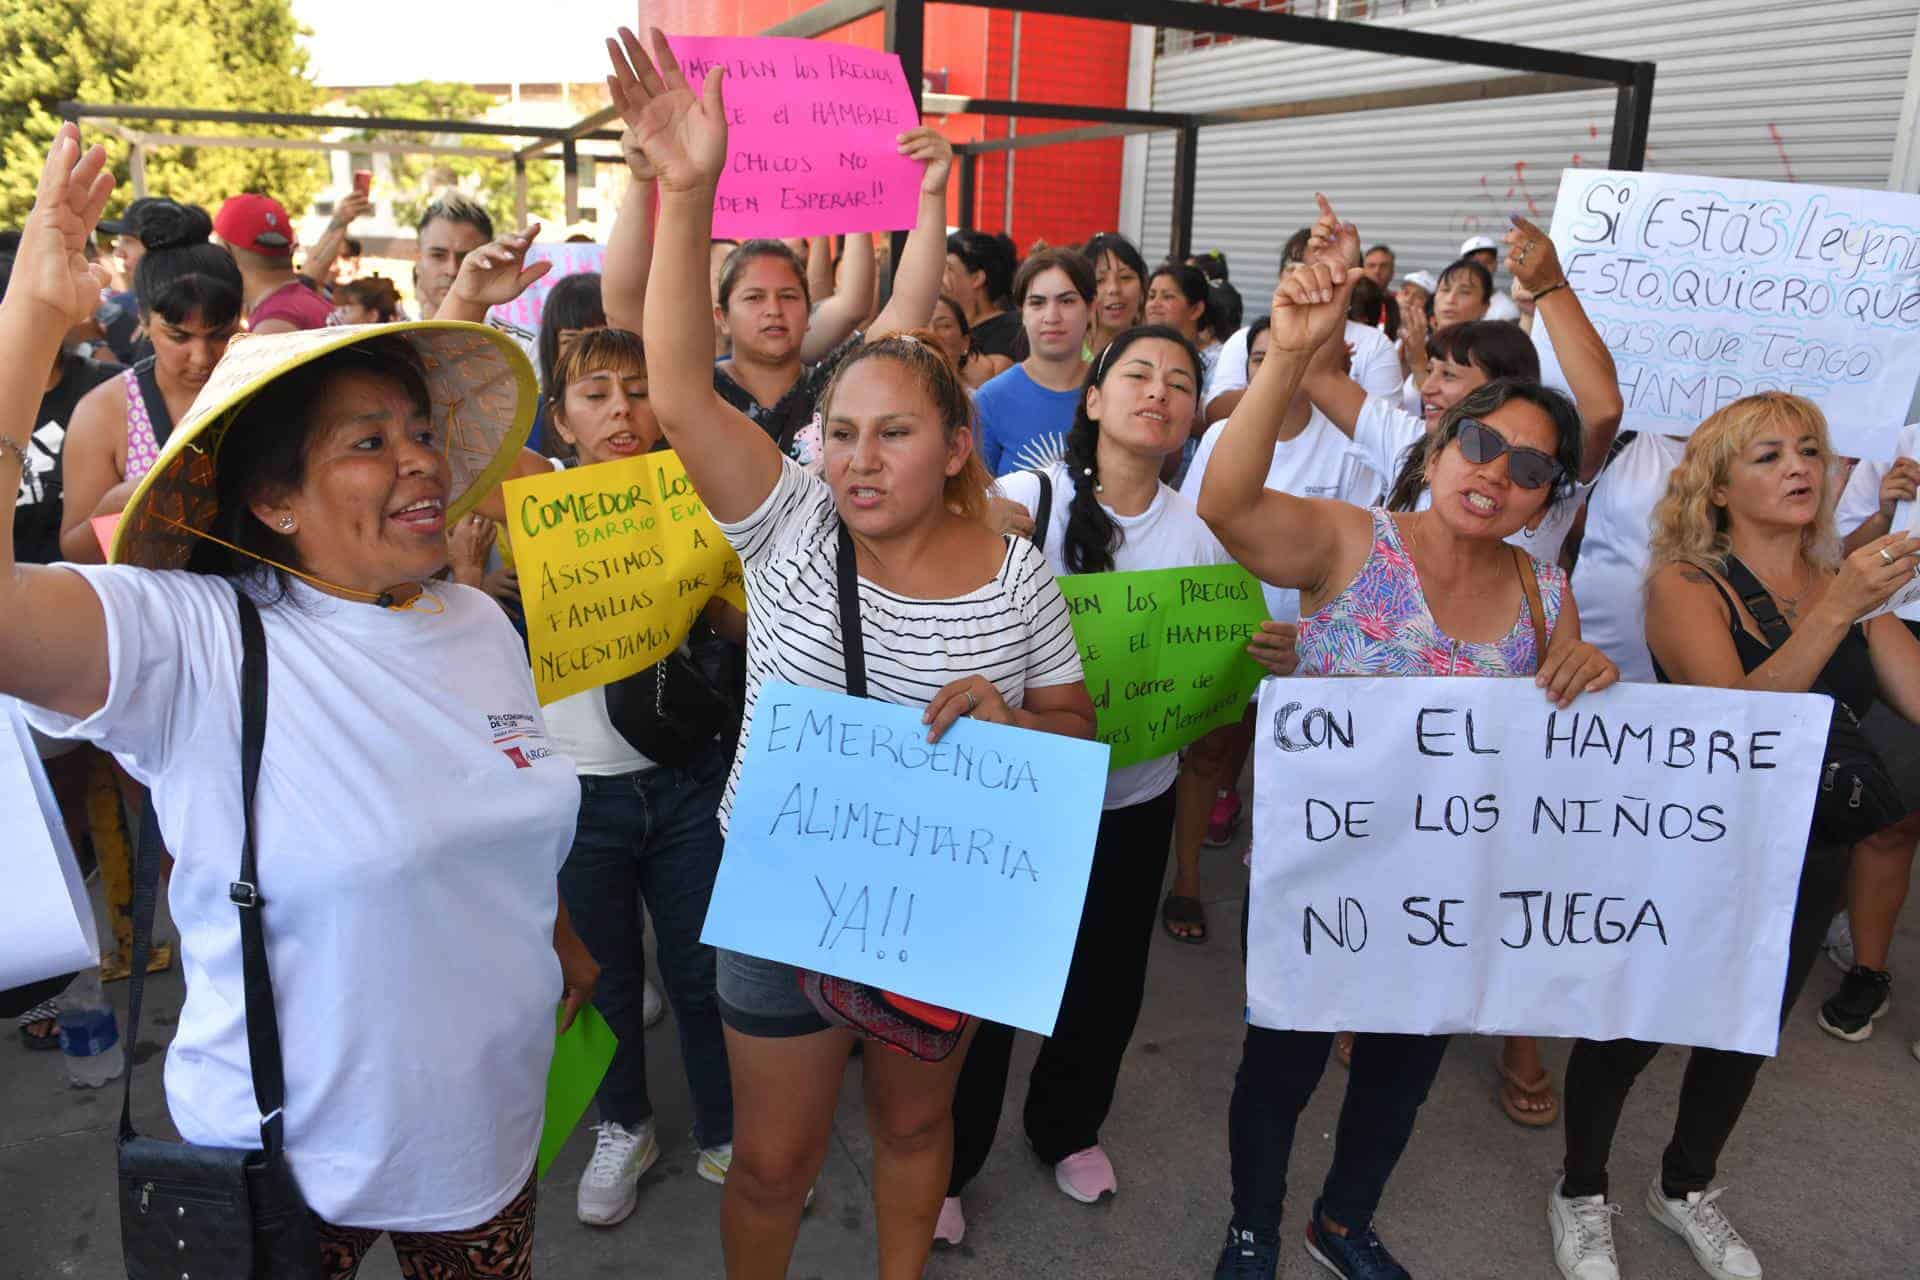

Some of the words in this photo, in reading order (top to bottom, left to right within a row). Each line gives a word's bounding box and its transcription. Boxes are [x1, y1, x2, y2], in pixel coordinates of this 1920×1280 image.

[811, 102, 899, 127] HAMBRE
[520, 484, 652, 539] COMEDOR
[692, 528, 710, 549] A
[1179, 577, 1250, 607] PRECIOS
[1166, 622, 1254, 646] HAMBRE
[1272, 700, 1355, 753] CON
[1416, 707, 1501, 758] EL
[1544, 710, 1783, 774] HAMBRE
[1305, 798, 1376, 843] DE
[1415, 793, 1501, 836] LOS
[1532, 795, 1728, 842] NIÑOS
[814, 874, 915, 963] YA!!
[1302, 896, 1369, 956] NO
[1403, 896, 1469, 947] SE
[1500, 889, 1669, 949] JUEGA
